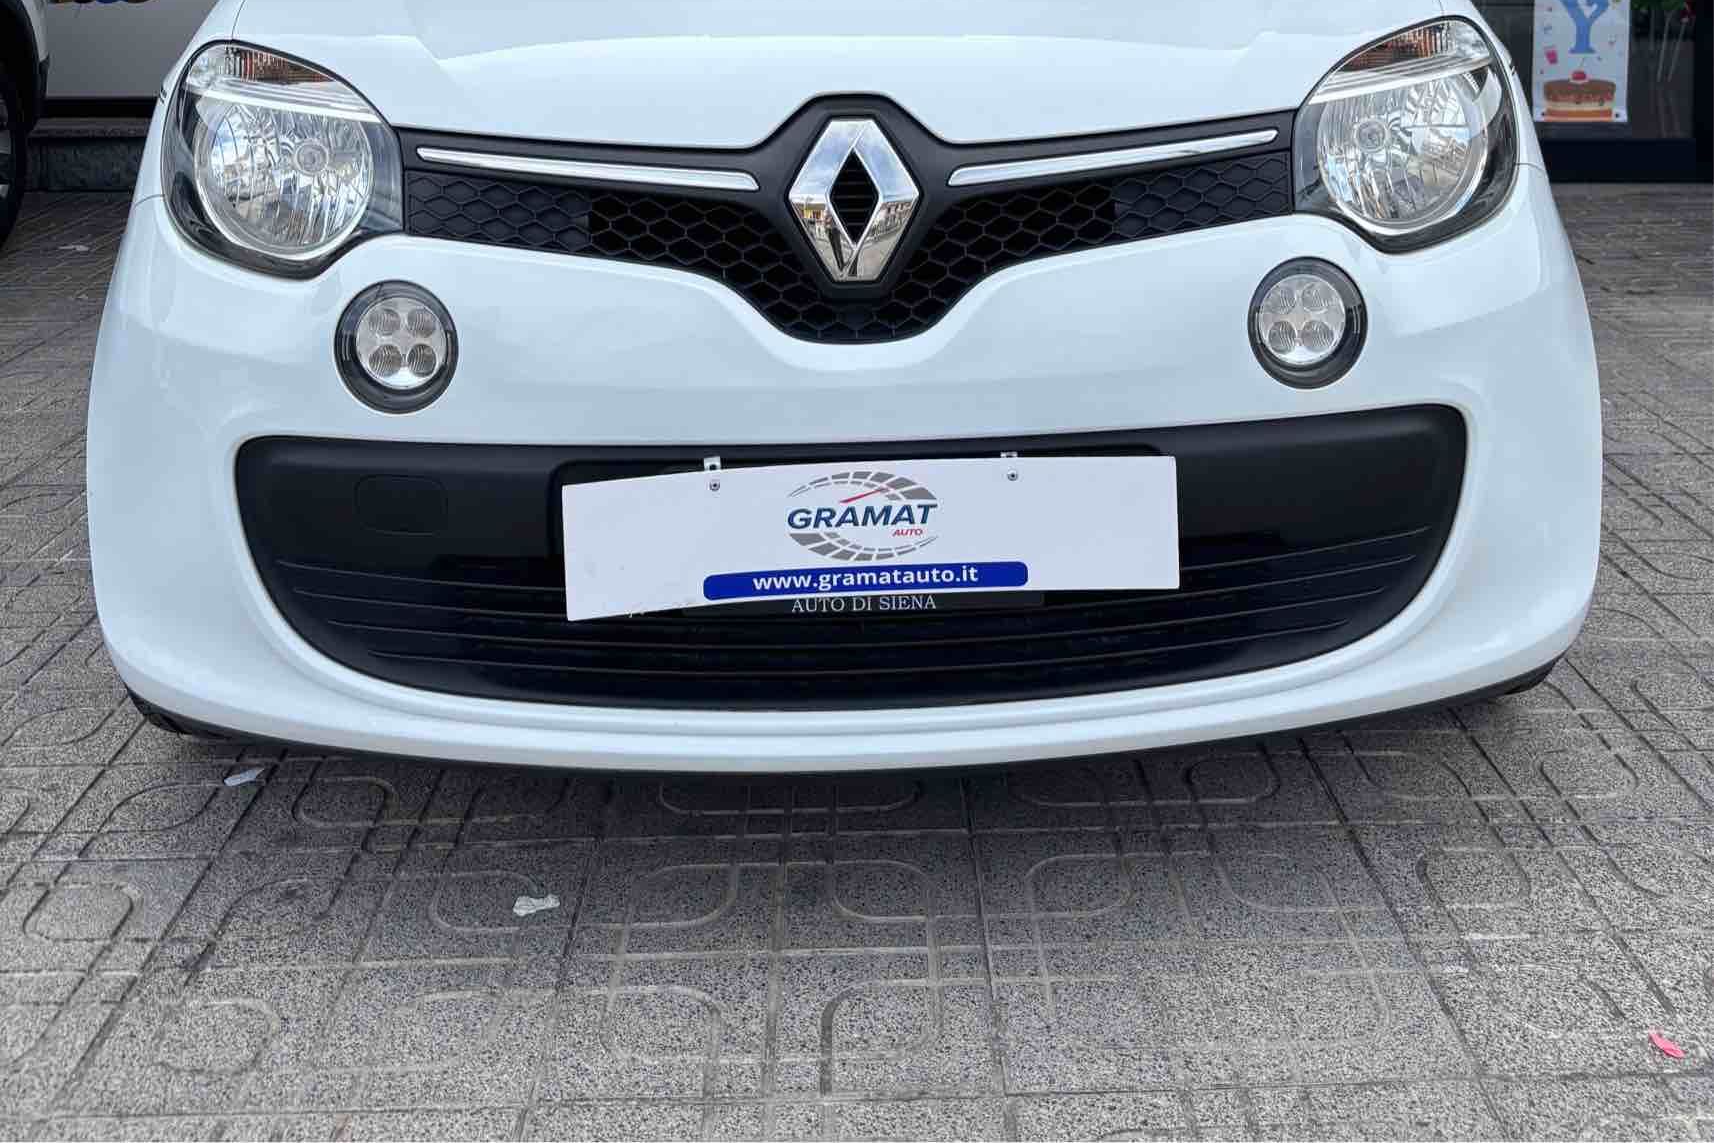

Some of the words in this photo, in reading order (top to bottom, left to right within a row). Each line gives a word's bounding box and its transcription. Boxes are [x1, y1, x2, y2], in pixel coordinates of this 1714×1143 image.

[787, 503, 938, 530] GRAMAT
[892, 527, 924, 538] AUTO
[752, 564, 979, 591] www.gramatauto.it
[791, 596, 846, 613] AUTO
[852, 595, 872, 611] DI
[879, 594, 937, 610] SIENA
